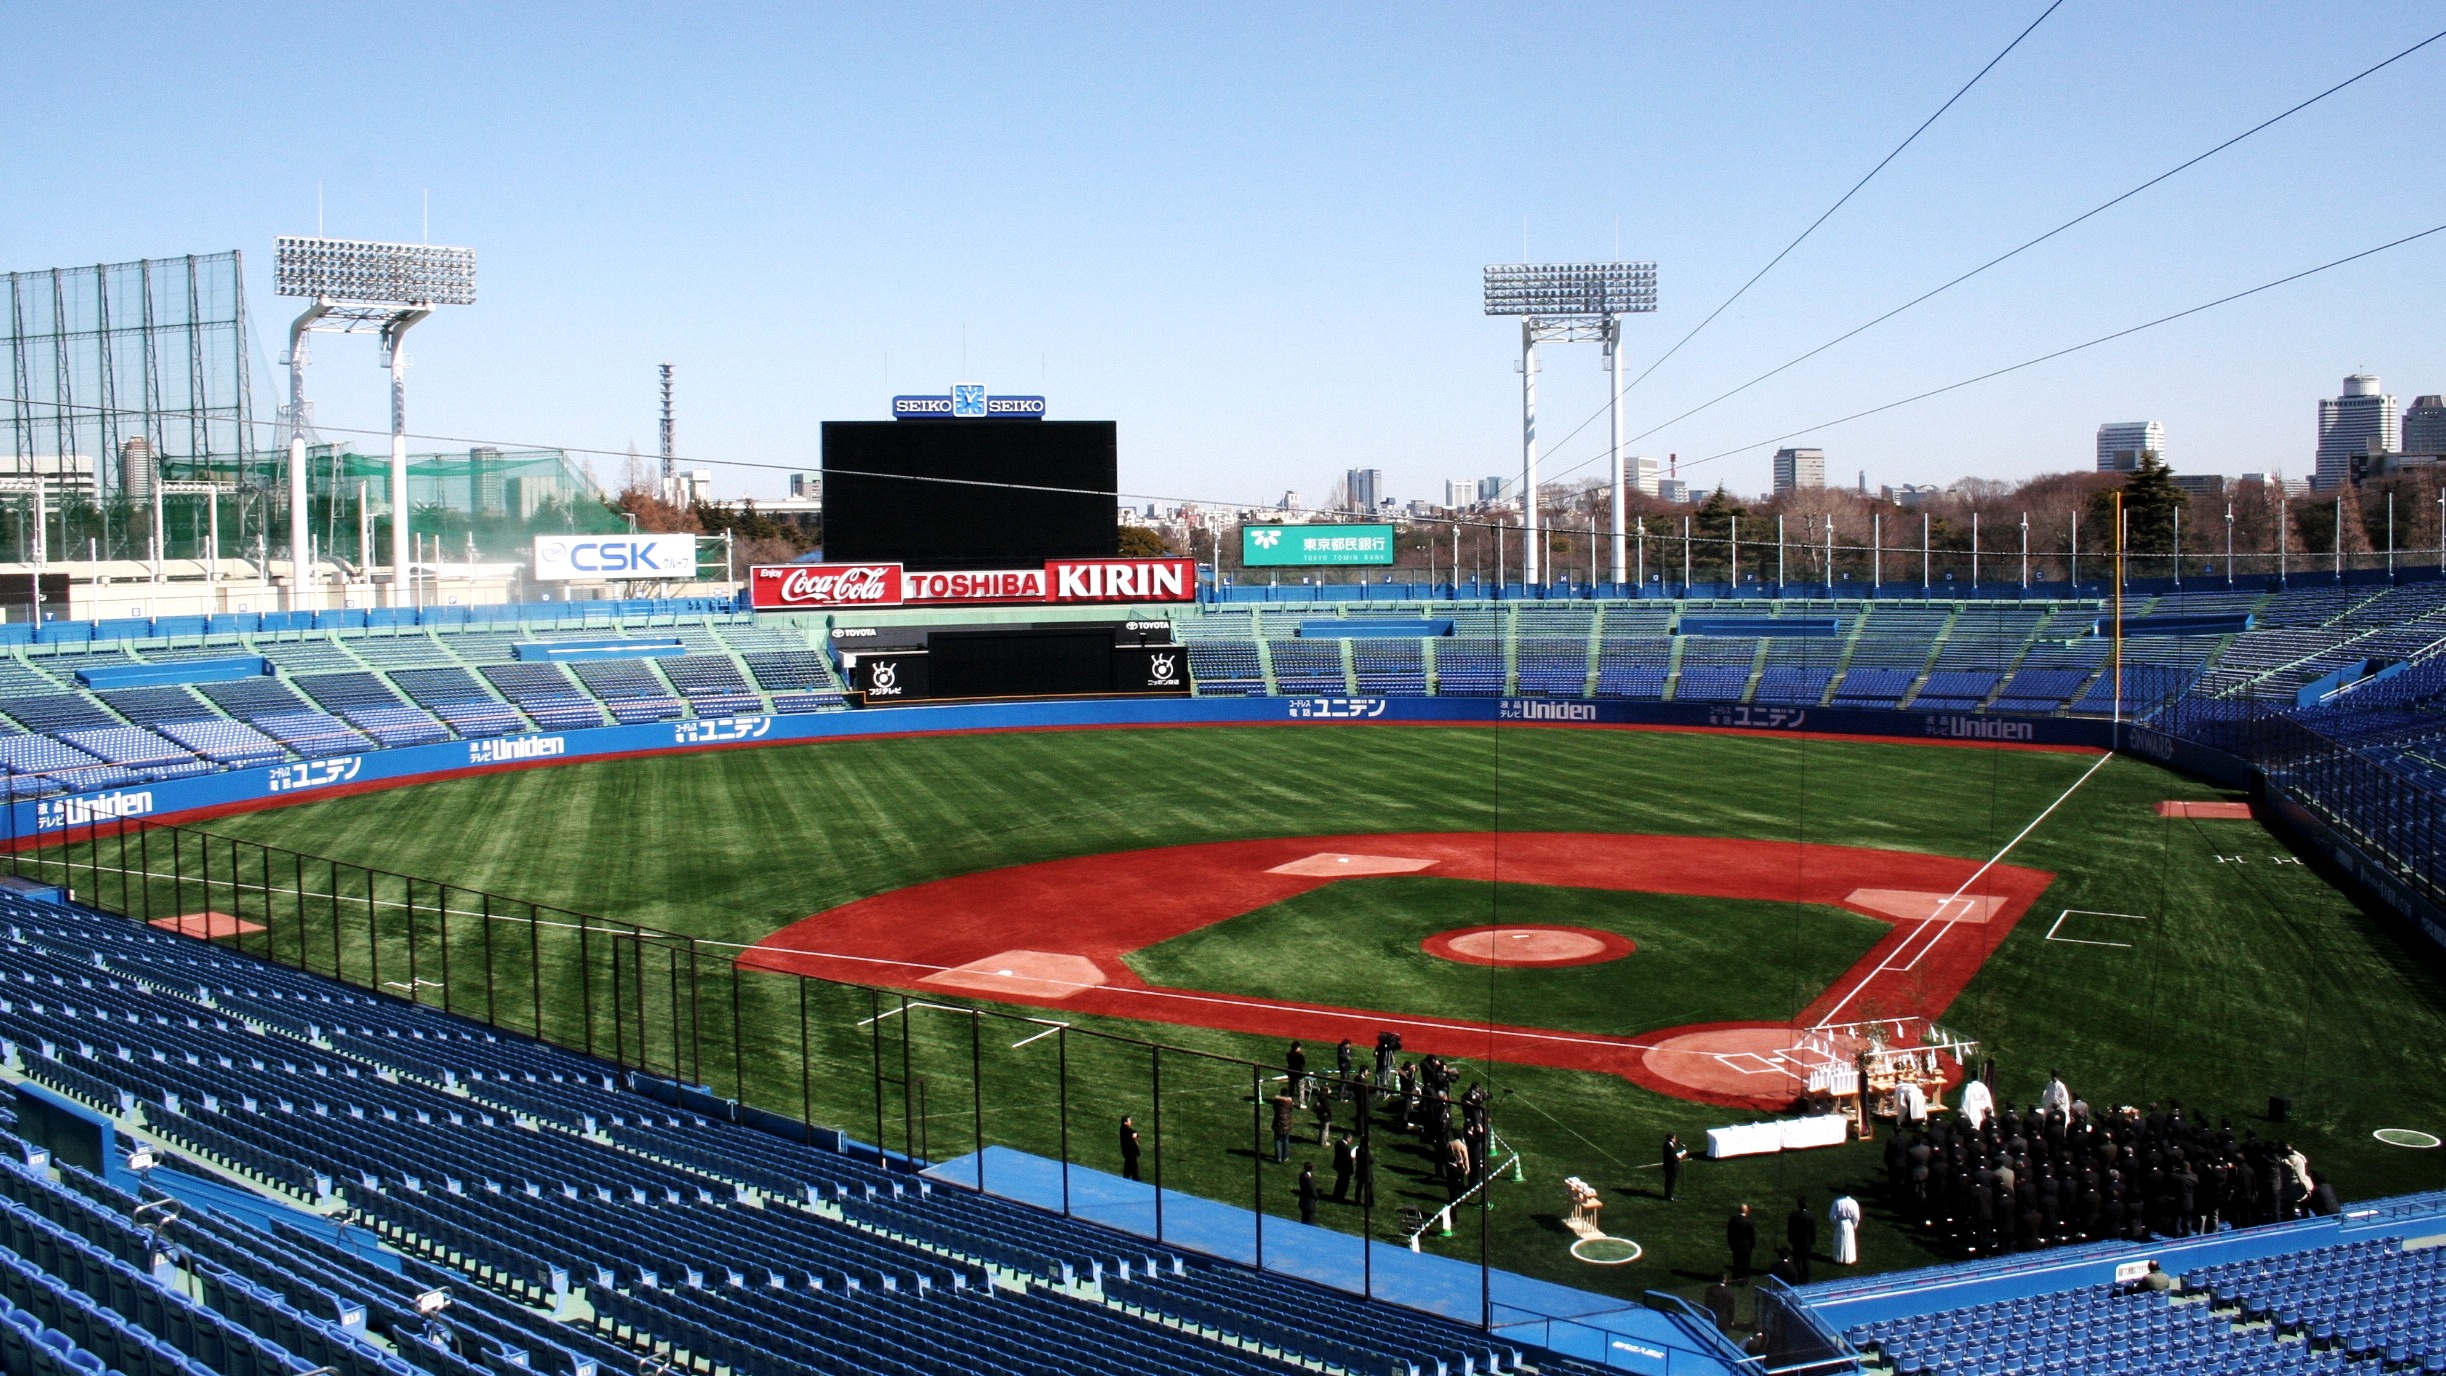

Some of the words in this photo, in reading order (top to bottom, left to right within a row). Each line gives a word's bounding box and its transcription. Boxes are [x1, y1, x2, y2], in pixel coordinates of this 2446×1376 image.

[896, 400, 951, 412] SEIKO
[989, 400, 1043, 412] SEIKO
[1303, 537, 1385, 551] 東京都民銀行
[571, 542, 661, 571] CSK
[760, 569, 783, 579] Enjoy
[1058, 564, 1183, 597] KIRIN
[781, 567, 889, 602] Coca-Cola
[910, 573, 1040, 597] TOSHIBA
[132, 608, 140, 616] S
[845, 628, 876, 637] TOYOTA
[868, 687, 902, 695] フジテレビ
[1313, 699, 1386, 717] ユニデン
[1500, 709, 1522, 718] テレビ
[1523, 700, 1596, 720] Uniden
[1733, 706, 1805, 728] ユニデン
[699, 717, 771, 741] ユニデン
[1950, 716, 2032, 740] Uniden
[470, 752, 491, 763] テレビ
[492, 736, 565, 761] Uniden
[292, 757, 361, 788] ユニデン
[38, 800, 65, 815] 液晶
[65, 790, 153, 825] Uniden
[38, 815, 65, 829] テレビ
